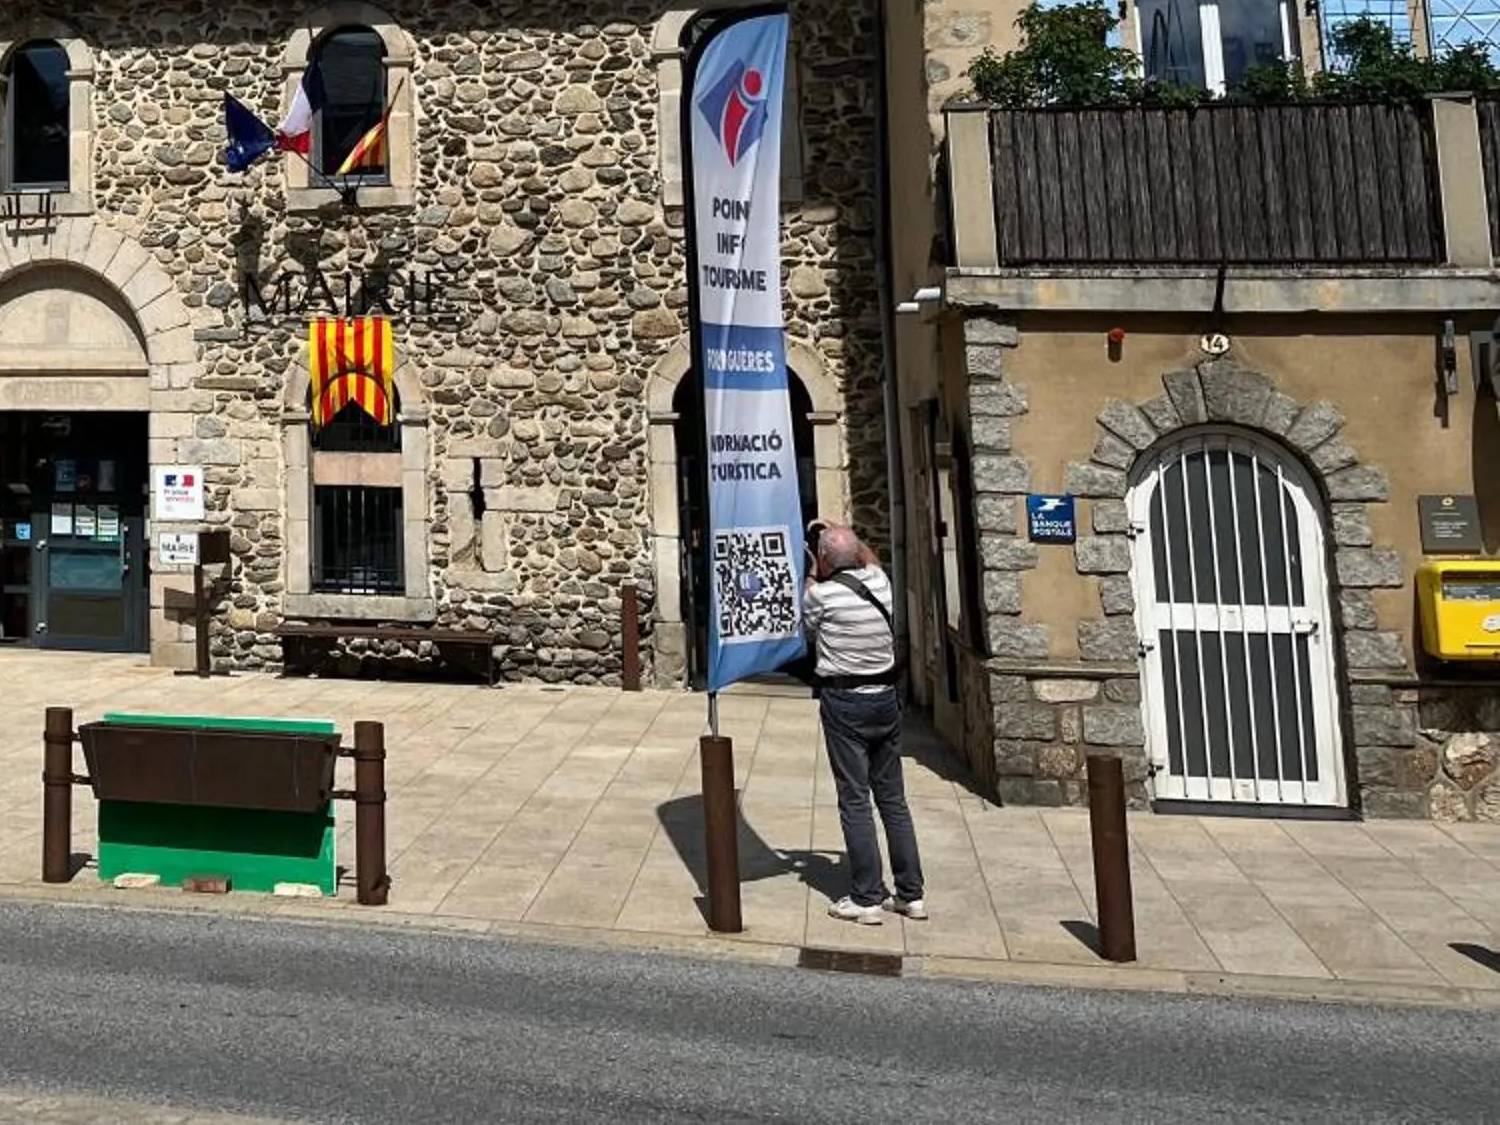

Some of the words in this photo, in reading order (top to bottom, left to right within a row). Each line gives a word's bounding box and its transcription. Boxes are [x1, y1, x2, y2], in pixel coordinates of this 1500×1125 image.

[244, 271, 450, 316] MAIRIE
[1206, 335, 1224, 350] 14
[1031, 512, 1045, 520] LA
[1031, 520, 1071, 528] BANQUE
[1033, 527, 1073, 537] POSTALE
